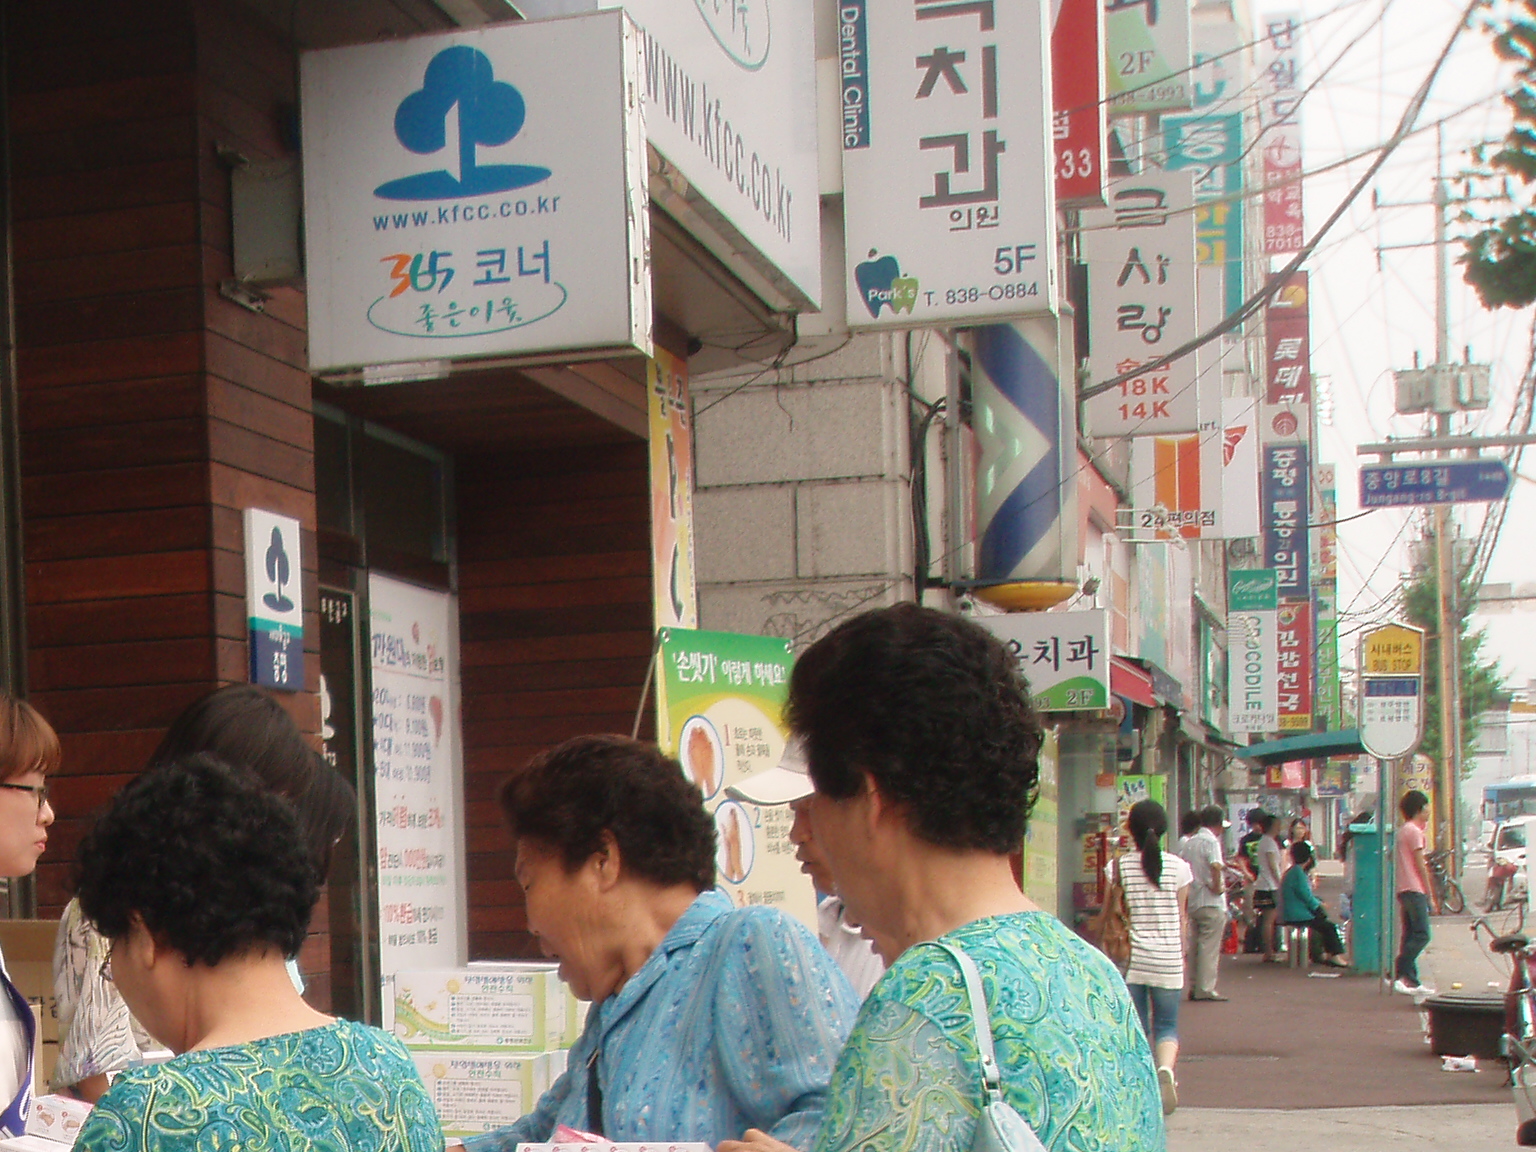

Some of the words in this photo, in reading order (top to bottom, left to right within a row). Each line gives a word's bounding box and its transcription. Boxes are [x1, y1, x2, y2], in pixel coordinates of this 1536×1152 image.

[841, 6, 861, 79] Dental
[1118, 50, 1154, 76] 2F
[843, 86, 864, 148] Clinic
[644, 27, 793, 243] www.kfcc.co.kr
[1053, 149, 1092, 179] 33
[372, 195, 561, 231] www.kfcc.co.kr
[949, 206, 1000, 232] 의원
[379, 250, 455, 298] 365
[473, 240, 551, 286] 코너
[994, 245, 1037, 275] 5F
[868, 285, 916, 303] Park's
[1117, 377, 1171, 397] 18K
[1117, 401, 1171, 421] 14K
[1370, 644, 1413, 656] 시내버스
[1277, 629, 1301, 712] 김밥천국
[1065, 688, 1095, 706] 2F
